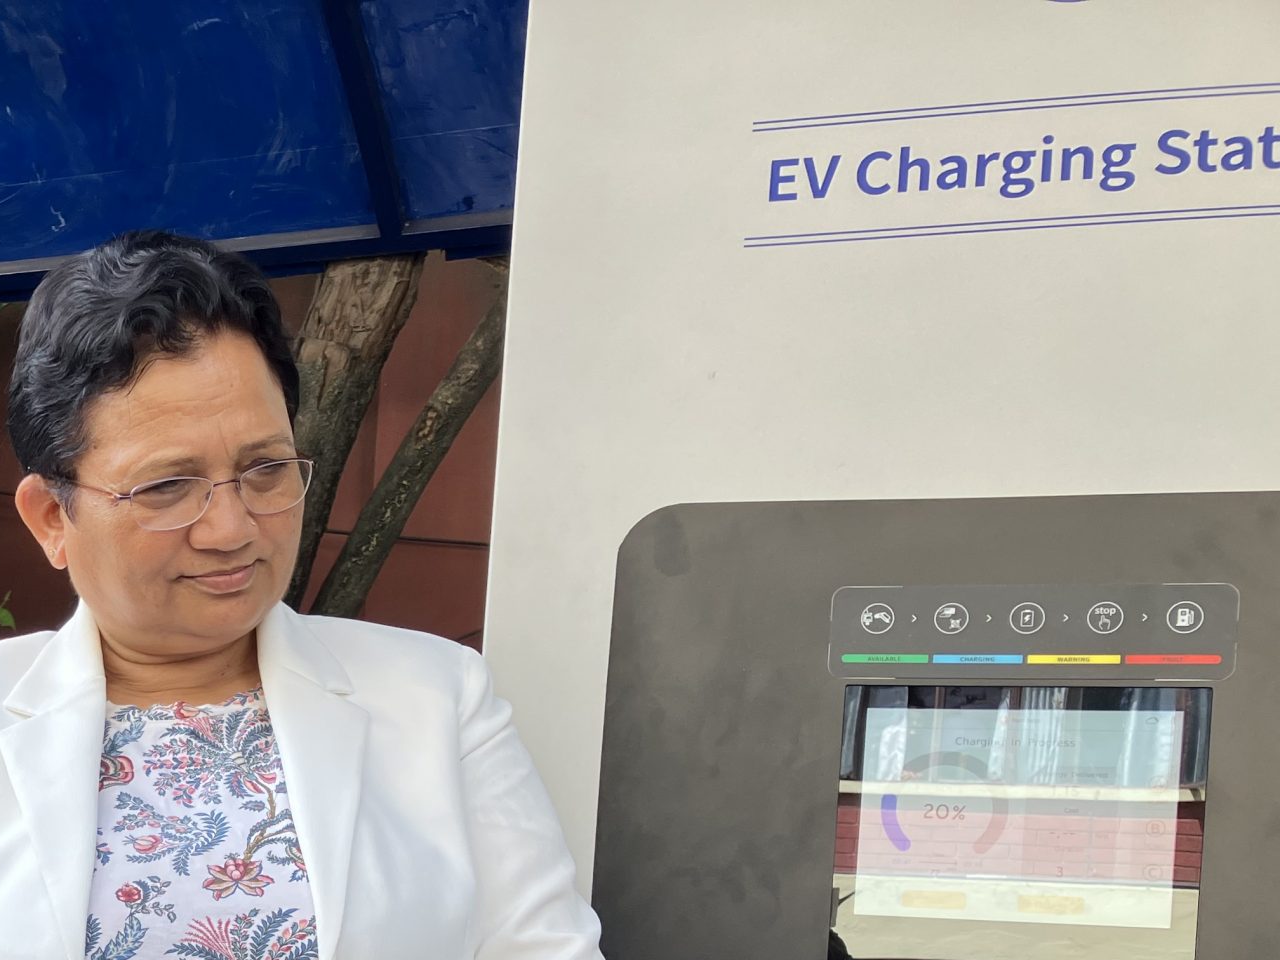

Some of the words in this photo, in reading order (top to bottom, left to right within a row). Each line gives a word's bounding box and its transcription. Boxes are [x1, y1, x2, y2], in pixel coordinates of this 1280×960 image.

[768, 154, 842, 202] EV
[856, 134, 1136, 199] Charging
[1155, 126, 1280, 175] Stat
[1094, 606, 1117, 617] stop
[923, 803, 967, 821] 20%
[1055, 866, 1064, 878] 3
